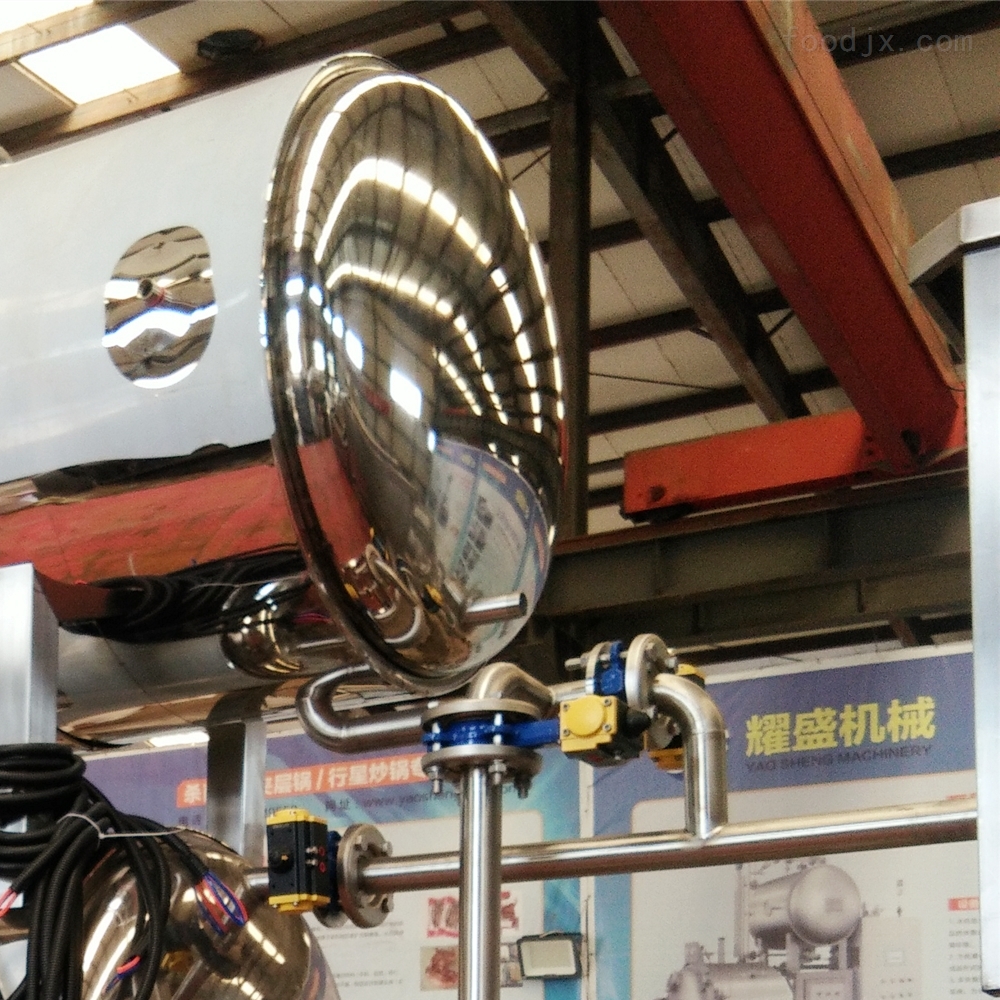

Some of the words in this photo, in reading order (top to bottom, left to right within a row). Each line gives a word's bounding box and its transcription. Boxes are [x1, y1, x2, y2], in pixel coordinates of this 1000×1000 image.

[745, 696, 937, 757] 耀盛机械
[747, 760, 777, 773] YAO
[780, 755, 834, 771] SHENG
[836, 745, 932, 767] MACHINERY
